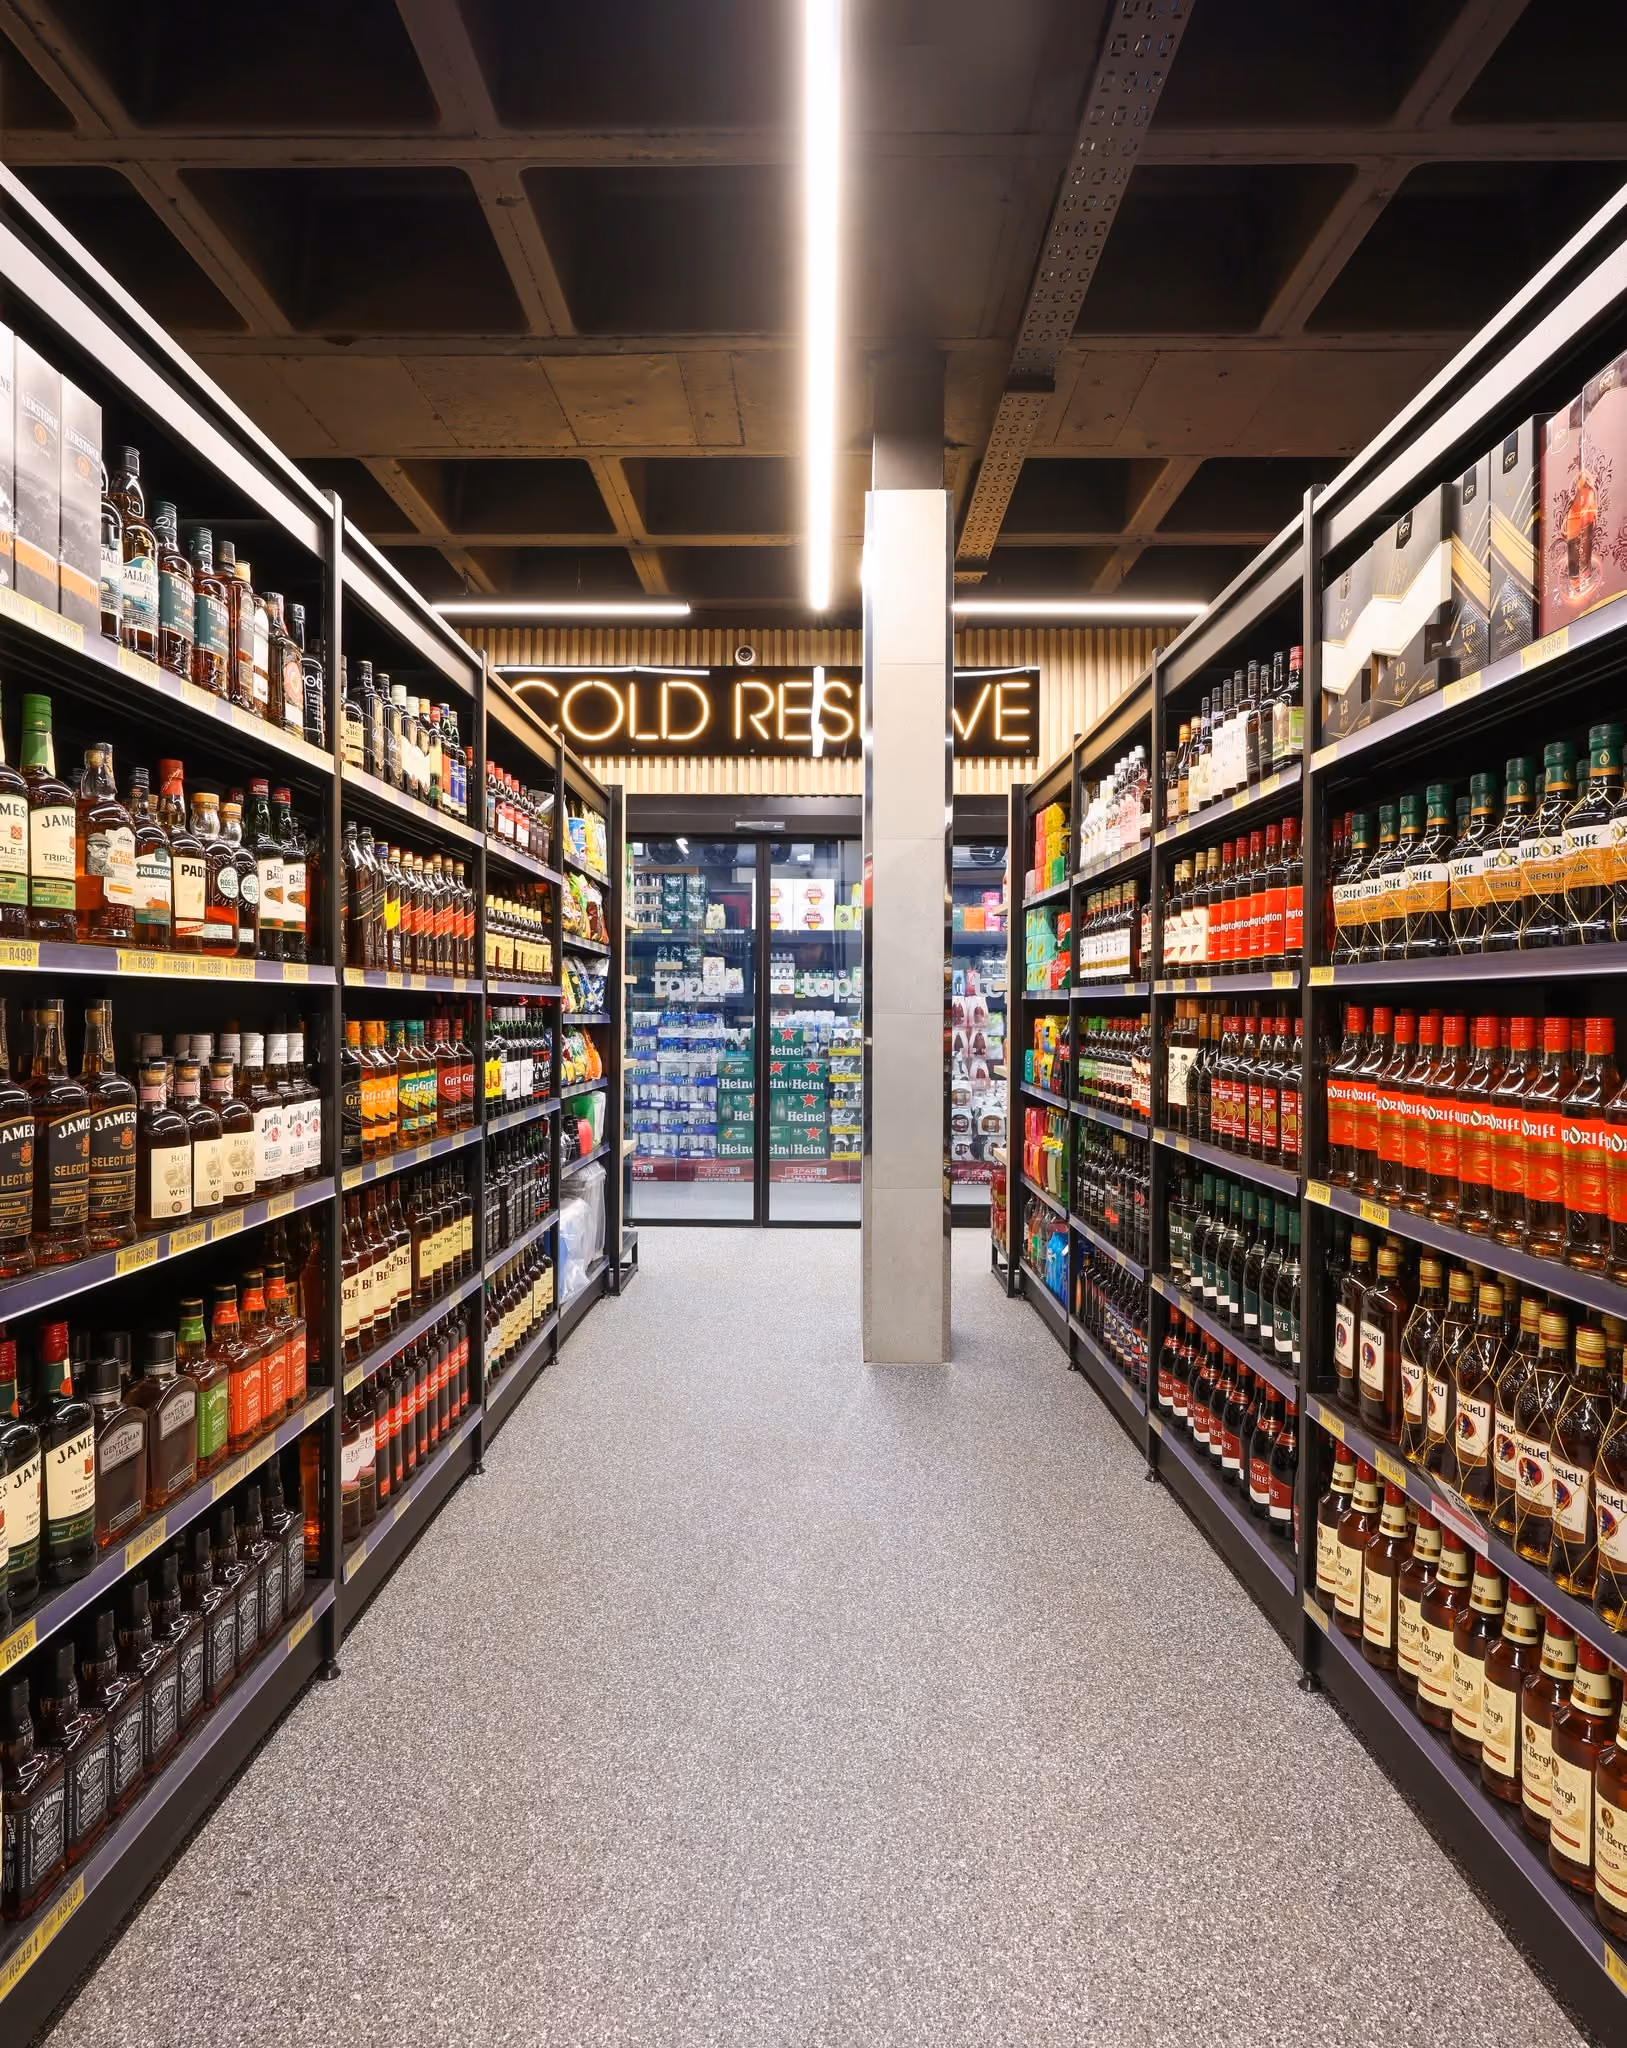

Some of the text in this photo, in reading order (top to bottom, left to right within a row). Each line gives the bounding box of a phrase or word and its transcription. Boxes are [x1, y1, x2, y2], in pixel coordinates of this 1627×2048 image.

[1395, 662, 1406, 680] 10
[733, 681, 1030, 741] RESVE
[770, 1045, 803, 1056] eine
[0, 1124, 35, 1144] AMES
[54, 1164, 85, 1177] SELECT
[91, 1156, 125, 1168] SELECT
[103, 1428, 140, 1456] GENTLEMAN
[6, 1637, 29, 1665] R399
[31, 1806, 44, 1831] JACK
